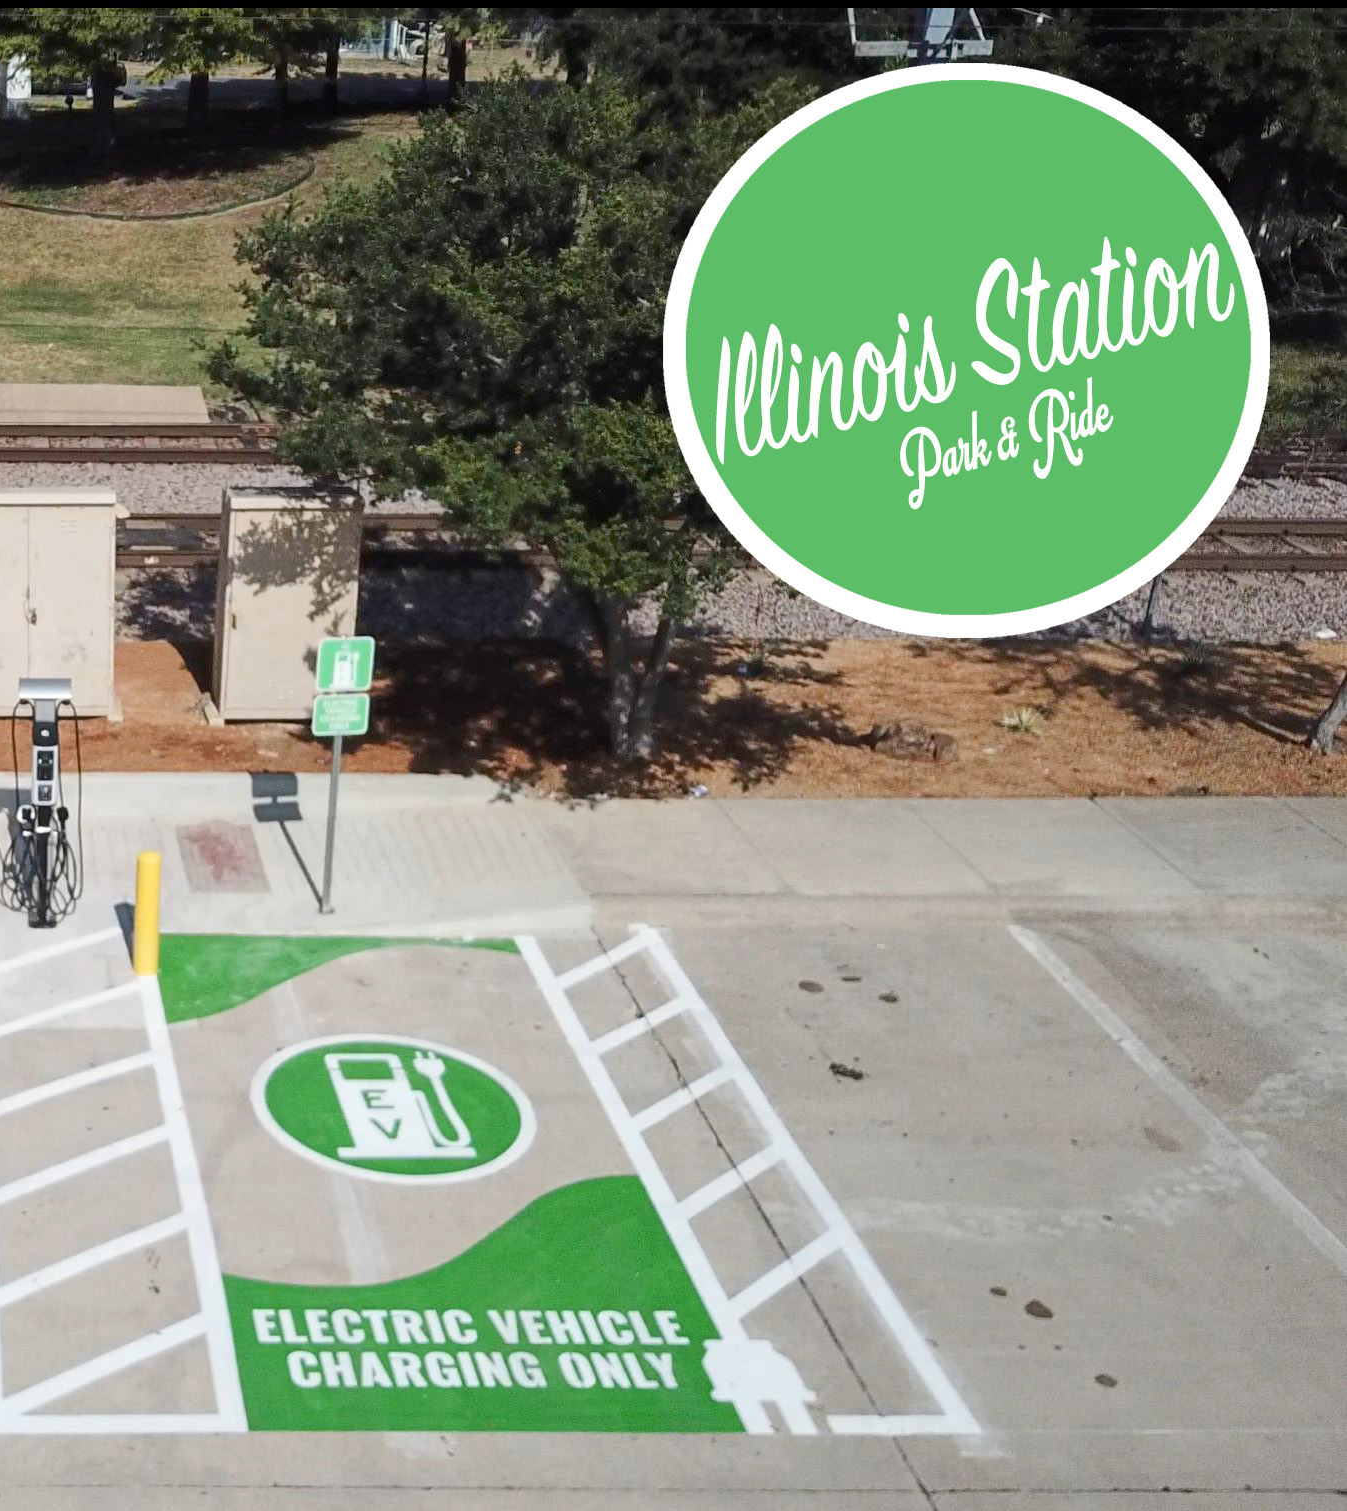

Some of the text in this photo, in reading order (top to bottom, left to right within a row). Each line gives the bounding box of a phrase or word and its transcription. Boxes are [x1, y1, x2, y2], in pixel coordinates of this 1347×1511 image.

[252, 1308, 690, 1346] ELECTRIC VEHICLE
[286, 1351, 678, 1389] CHARGING ONLY
